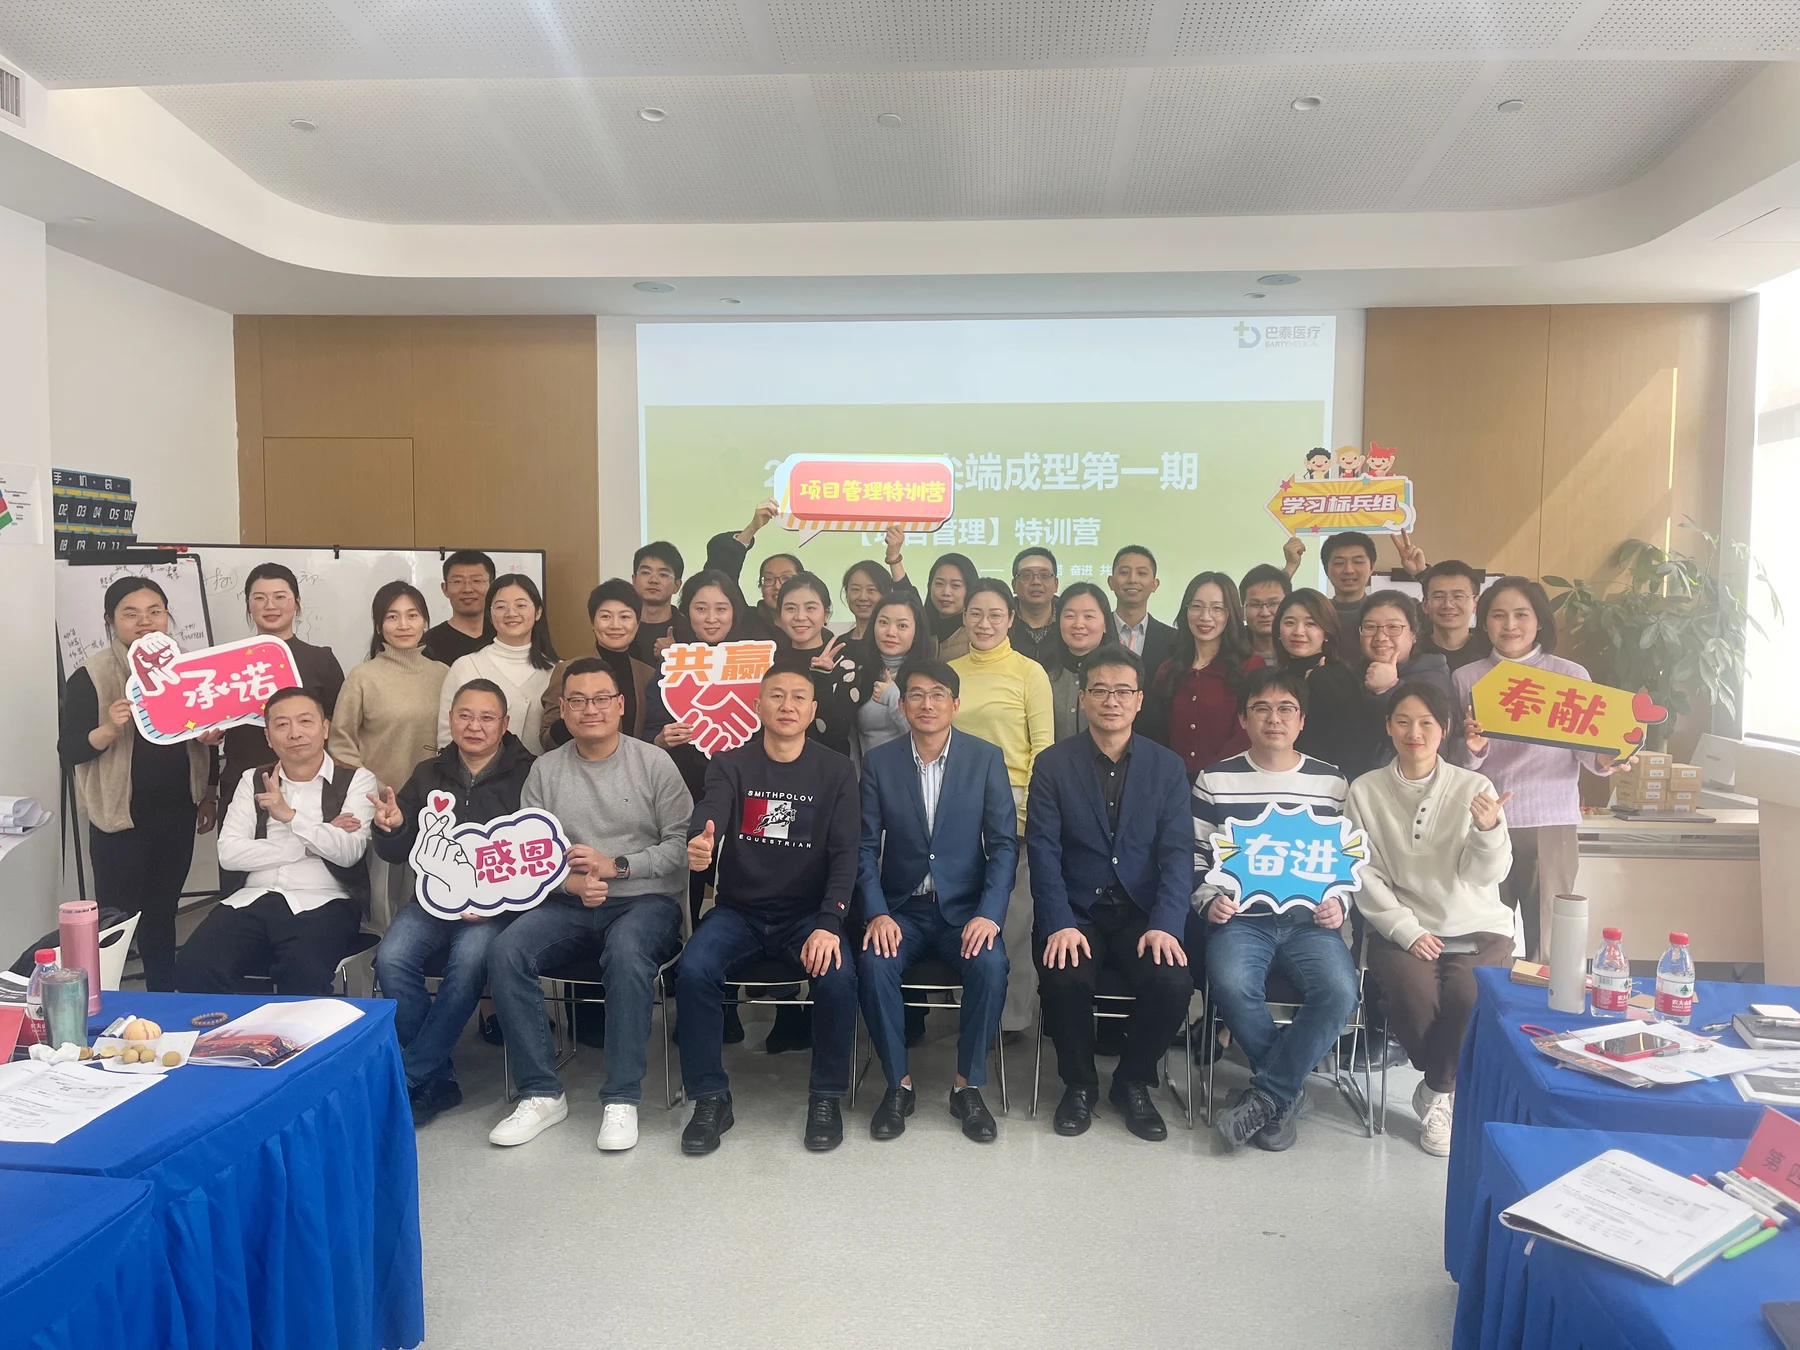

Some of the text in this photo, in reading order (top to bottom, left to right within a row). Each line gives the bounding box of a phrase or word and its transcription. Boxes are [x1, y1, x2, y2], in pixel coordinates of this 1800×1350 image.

[1265, 326, 1321, 339] 巴泰医疗
[800, 479, 947, 503] 项目管理特训营
[58, 504, 133, 521] 02 03 04 05 06
[1281, 494, 1398, 515] 学习标兵组
[1070, 564, 1093, 576] 奋进
[665, 644, 773, 684] 共赢
[180, 661, 279, 710] 承诺
[1498, 677, 1607, 737] 奉献
[748, 790, 813, 802] SMITHPOLOV
[739, 834, 811, 848] EQUESTRIAN
[475, 839, 556, 884] 感恩
[1243, 833, 1339, 883] 奋进
